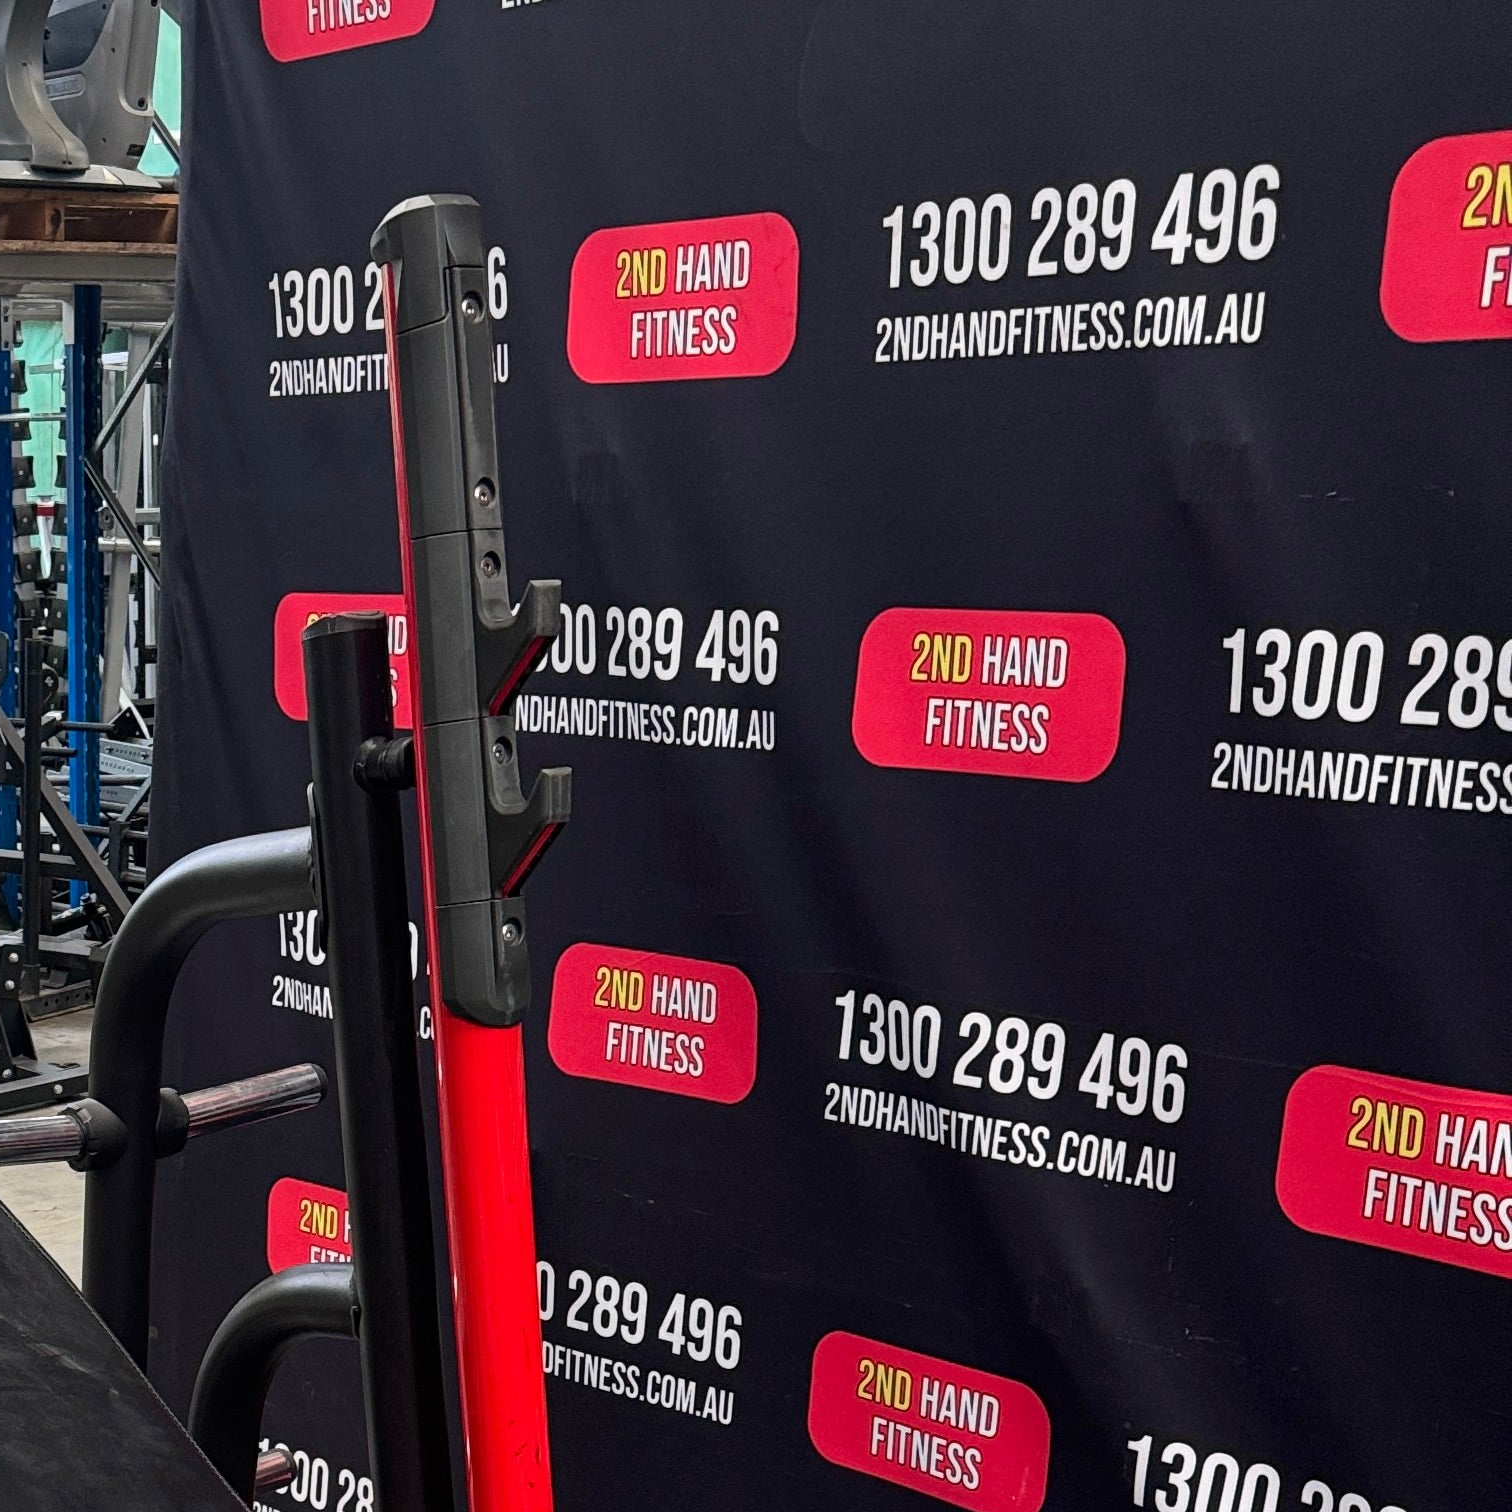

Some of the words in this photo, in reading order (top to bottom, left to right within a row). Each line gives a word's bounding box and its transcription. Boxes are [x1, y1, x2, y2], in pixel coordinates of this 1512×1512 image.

[883, 194, 1011, 288] 1300
[1028, 179, 1136, 276] 289
[1151, 164, 1279, 265] 496
[269, 266, 353, 337] 1300
[617, 249, 666, 297] 2ND
[676, 241, 749, 292] HAND
[632, 306, 736, 357] FITNESS
[876, 292, 1265, 362] 2NDHANDFITNESS.COM.AU
[536, 603, 596, 675] 00
[607, 607, 683, 680] 289
[696, 610, 778, 685] 496
[912, 634, 971, 682] 2ND
[982, 636, 1067, 687] HAND
[1223, 629, 1383, 722] 1300
[515, 695, 774, 750] NDHANDFITNESS.COM.AU
[926, 699, 1048, 753] FITNESS
[279, 909, 326, 966] 130
[595, 967, 643, 1011] 2ND
[652, 975, 716, 1023] HAND
[607, 1022, 704, 1076] FITNESS
[836, 990, 941, 1078] 1300
[953, 1012, 1065, 1099] 289
[1079, 1033, 1187, 1123] 496
[825, 1083, 1175, 1192] 2NDHANDFITNESS.COM.AU
[1349, 1098, 1423, 1157] 2ND
[300, 1200, 337, 1238] 2ND
[1363, 1168, 1512, 1251] FITNESS
[567, 1270, 647, 1344] 289
[659, 1293, 742, 1369] 496
[542, 1340, 735, 1427] DFITNESS.COM.AU
[858, 1360, 911, 1410] 2ND
[921, 1378, 998, 1437] HAND
[872, 1417, 981, 1489] FITNESS
